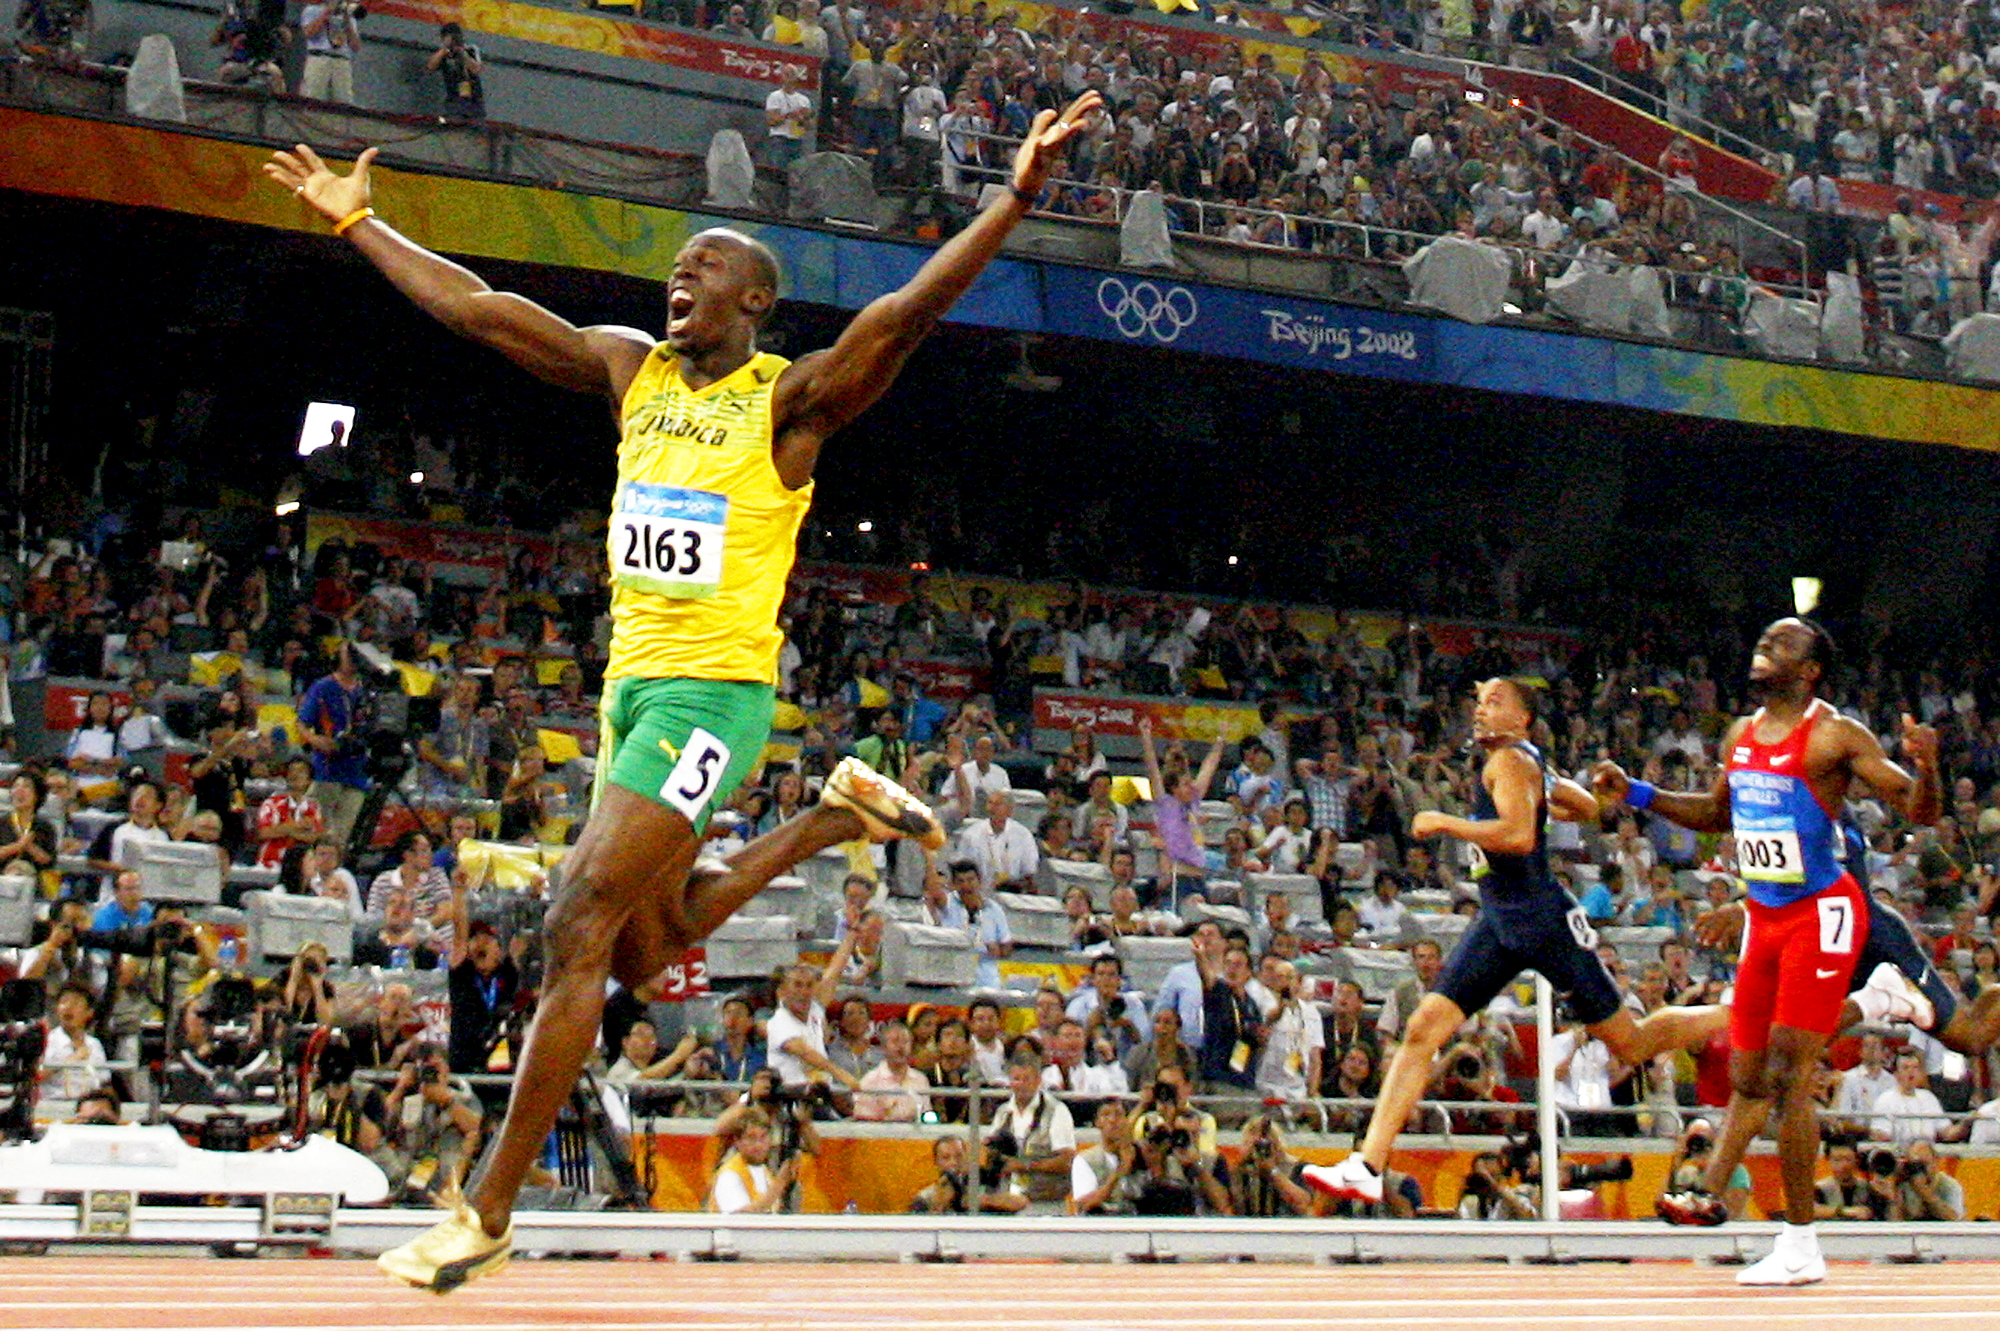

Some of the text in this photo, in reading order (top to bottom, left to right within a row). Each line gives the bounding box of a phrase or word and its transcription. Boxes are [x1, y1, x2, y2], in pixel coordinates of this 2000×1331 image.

[1260, 309, 1418, 361] Beijing 2008
[623, 523, 703, 575] 2163
[678, 746, 721, 801] 5
[1827, 904, 1845, 945] 7
